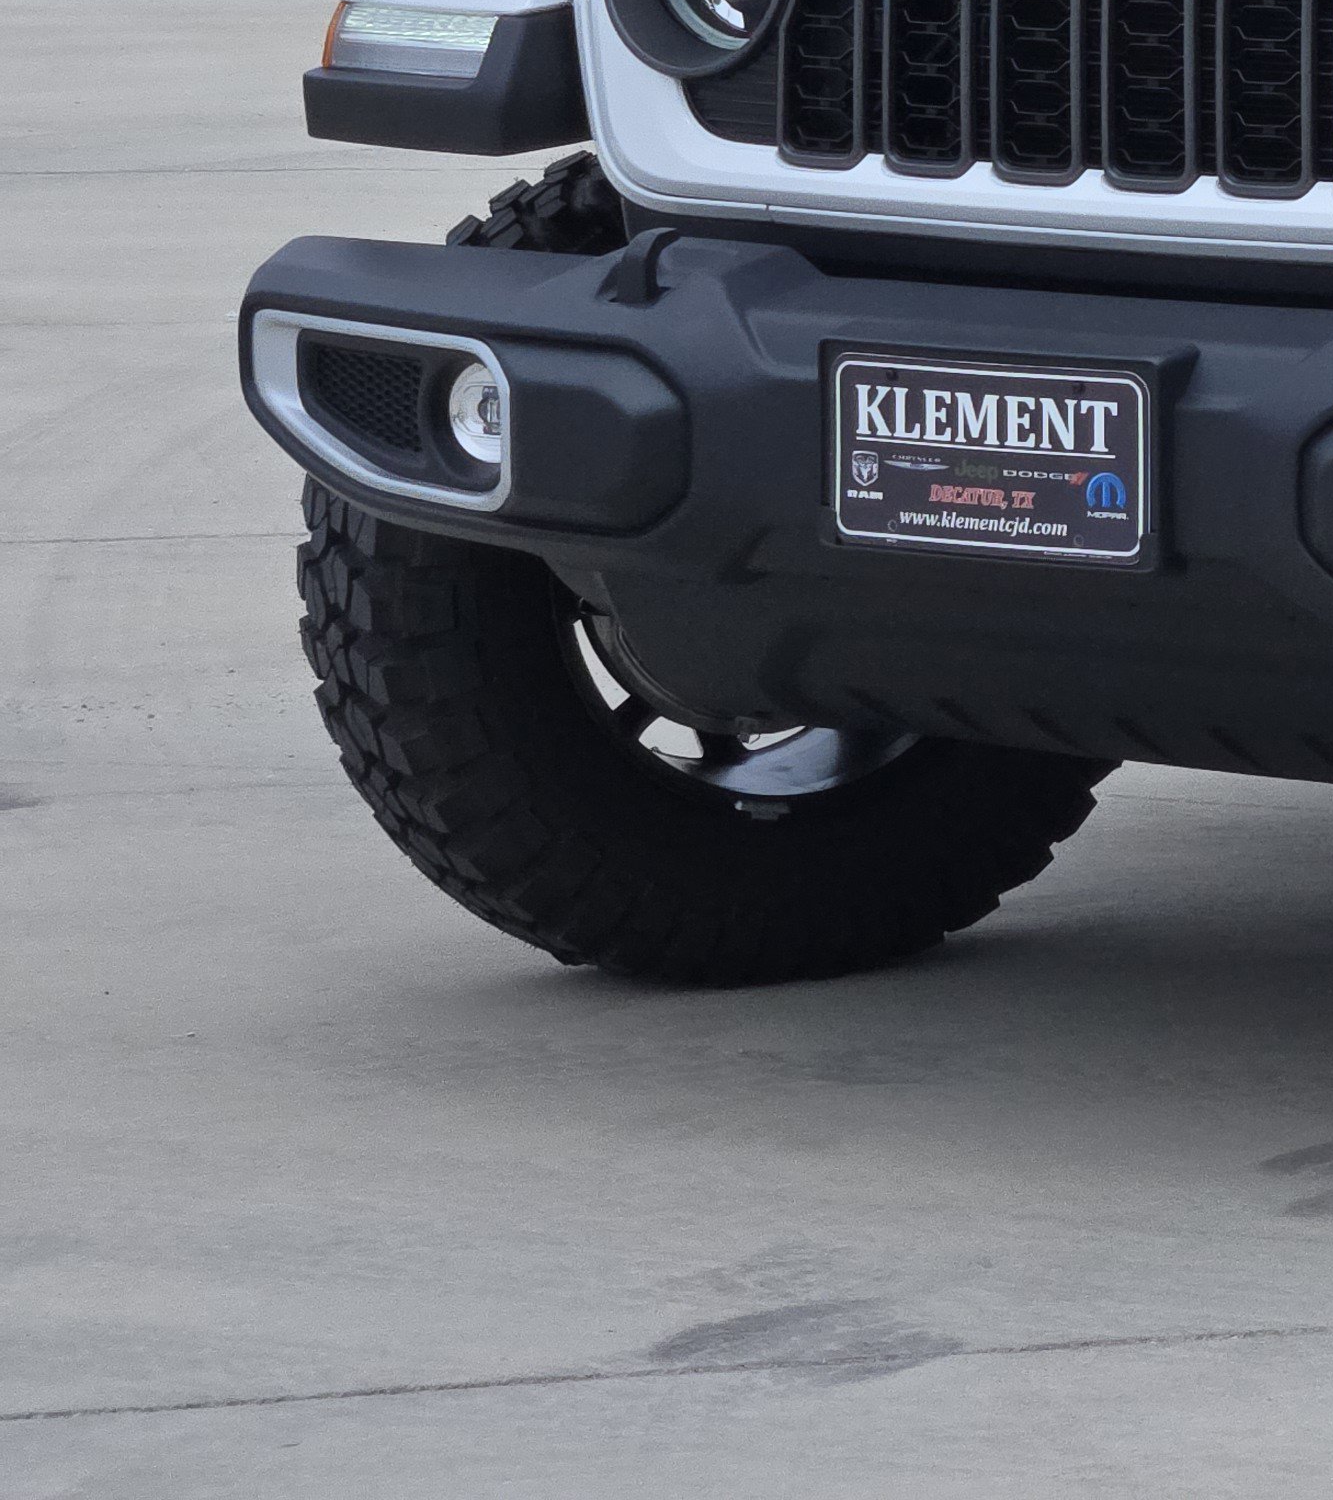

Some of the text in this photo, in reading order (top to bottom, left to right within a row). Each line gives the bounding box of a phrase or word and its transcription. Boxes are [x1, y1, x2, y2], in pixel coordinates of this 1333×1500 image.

[855, 383, 1118, 453] KLEMENT
[954, 460, 999, 481] Jeep
[1003, 469, 1077, 481] DODGE
[847, 489, 884, 501] RAM
[928, 484, 1037, 510] DECATUR, TX
[899, 510, 1069, 537] www.klementcjd.com
